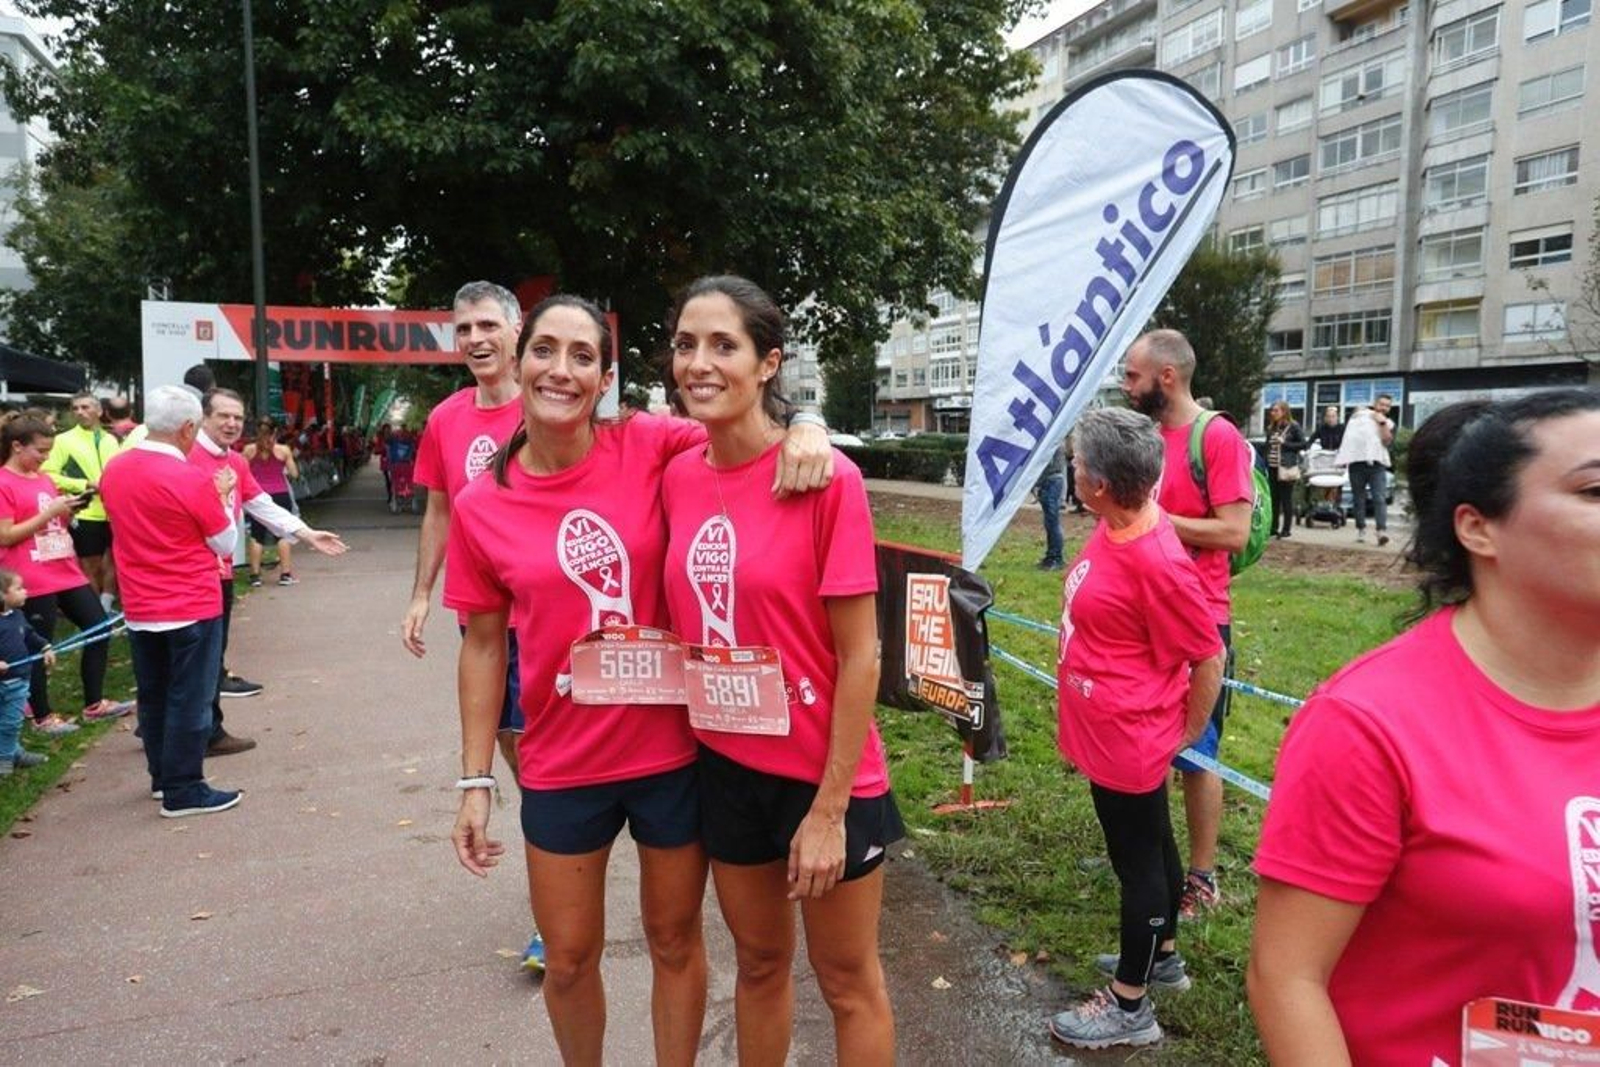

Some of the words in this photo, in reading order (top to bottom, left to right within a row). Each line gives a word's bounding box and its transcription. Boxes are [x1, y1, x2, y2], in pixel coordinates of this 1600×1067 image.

[975, 138, 1206, 511] Atlántico
[567, 518, 591, 537] VI
[708, 526, 724, 542] VI
[567, 535, 609, 558] VIGO
[696, 551, 729, 564] VIGO
[911, 583, 950, 612] SAV
[911, 613, 946, 645] THE
[600, 649, 662, 679] 5681
[910, 642, 955, 676] MUSI
[702, 672, 760, 707] 5891
[921, 680, 967, 712] EUROP
[1496, 1000, 1541, 1022] RUN
